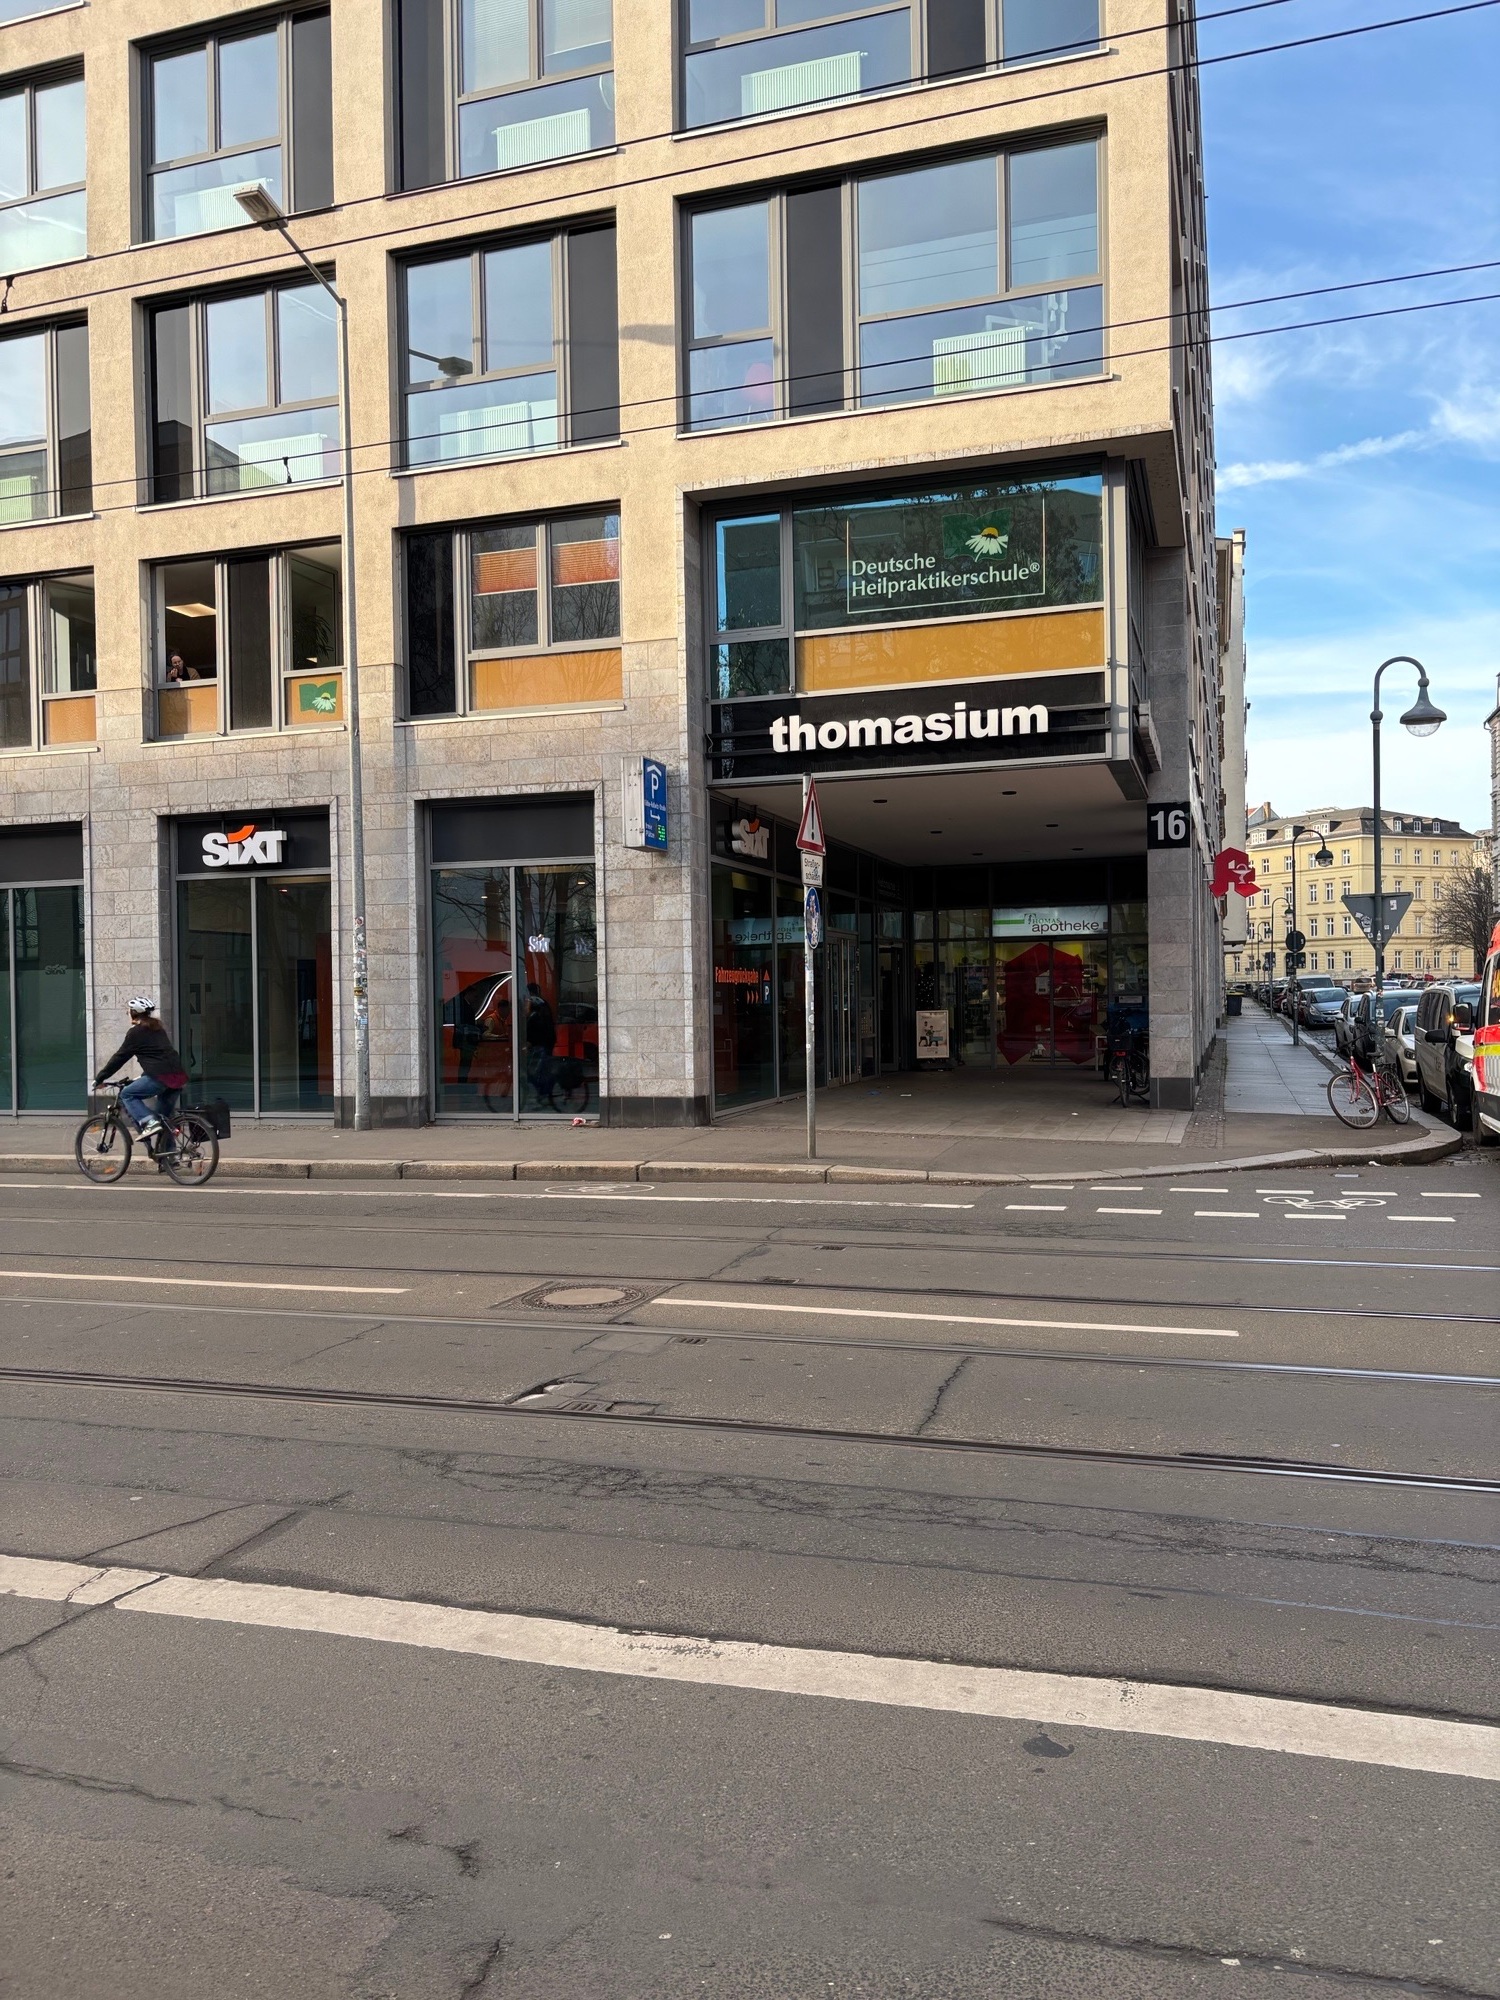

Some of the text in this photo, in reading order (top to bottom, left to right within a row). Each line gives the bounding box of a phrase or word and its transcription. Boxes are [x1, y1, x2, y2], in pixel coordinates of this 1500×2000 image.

[852, 553, 936, 576] Deutsche
[769, 701, 1049, 753] thomasium
[651, 773, 659, 799] P
[1150, 809, 1186, 840] 16
[1032, 919, 1099, 934] apotheke
